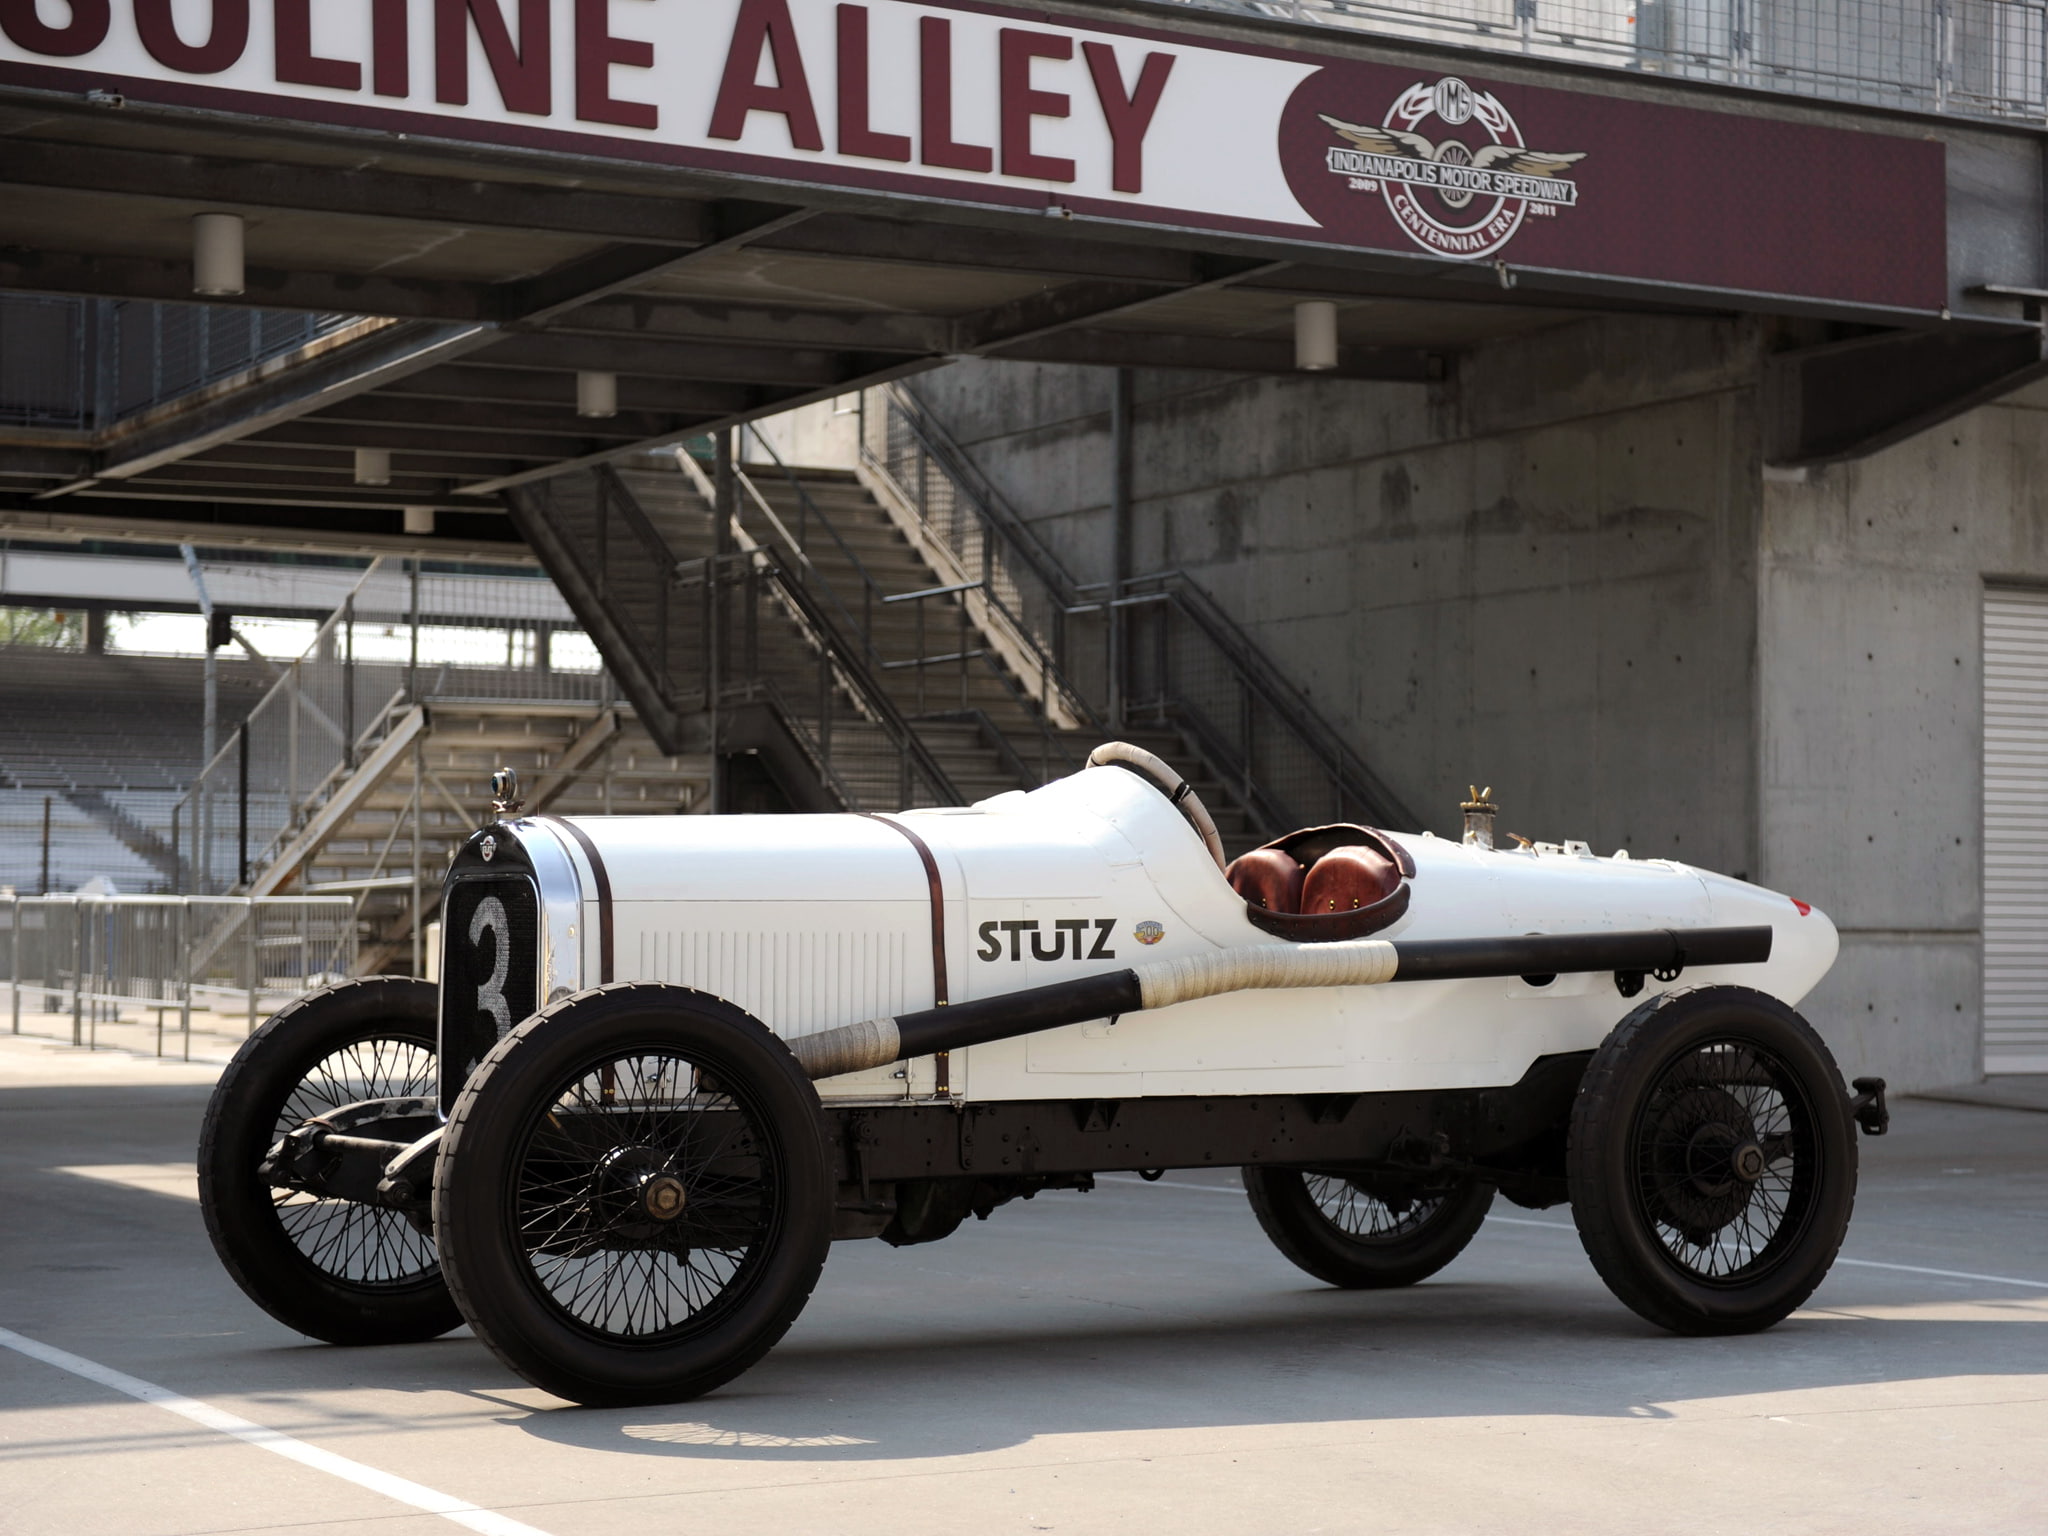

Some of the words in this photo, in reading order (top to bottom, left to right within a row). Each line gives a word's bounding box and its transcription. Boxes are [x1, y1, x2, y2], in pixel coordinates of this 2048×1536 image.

[707, 0, 1177, 193] ALLEY
[1437, 80, 1471, 121] IMS
[1333, 151, 1437, 182] INDIANAPOLIS
[1440, 167, 1494, 192] MOTOR
[1494, 177, 1570, 203] SPEEDWAY
[1348, 177, 1378, 192] 2009
[1394, 194, 1488, 251] CENTENNIAL
[1489, 208, 1516, 239] ERA
[1530, 202, 1556, 217] 2011
[976, 918, 1118, 963] STUTZ
[468, 896, 513, 1078] 3
